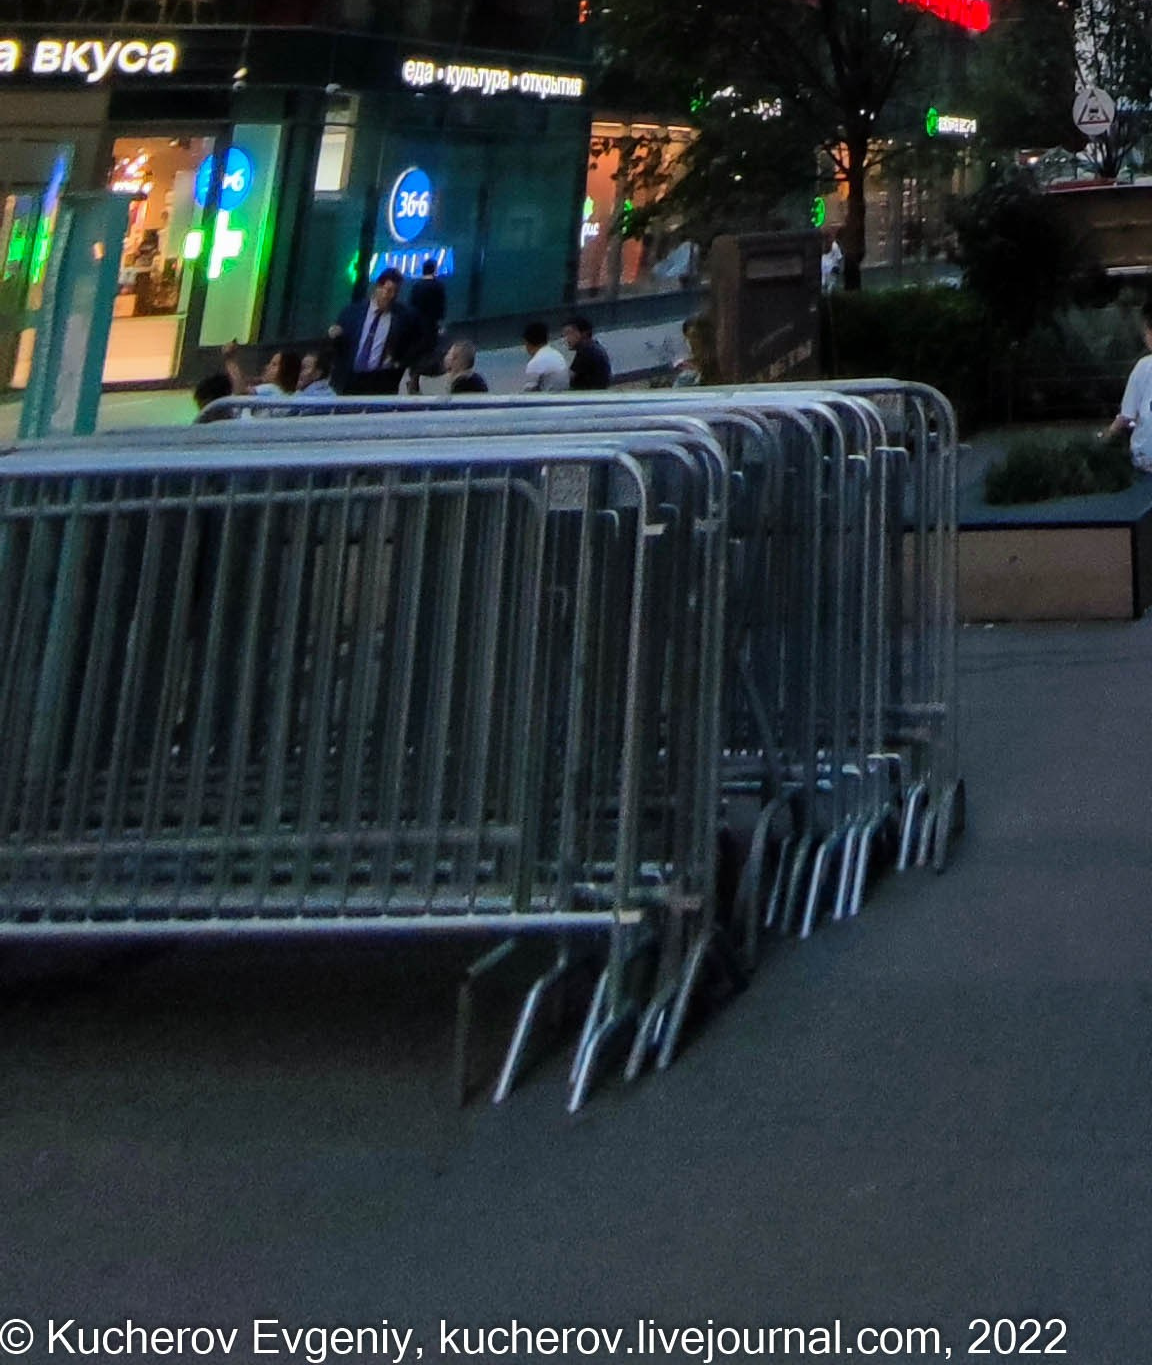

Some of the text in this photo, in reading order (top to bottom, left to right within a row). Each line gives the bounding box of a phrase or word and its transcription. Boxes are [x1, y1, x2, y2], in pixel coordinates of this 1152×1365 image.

[32, 40, 177, 83] вкуса
[402, 60, 583, 100] еда культура открытия
